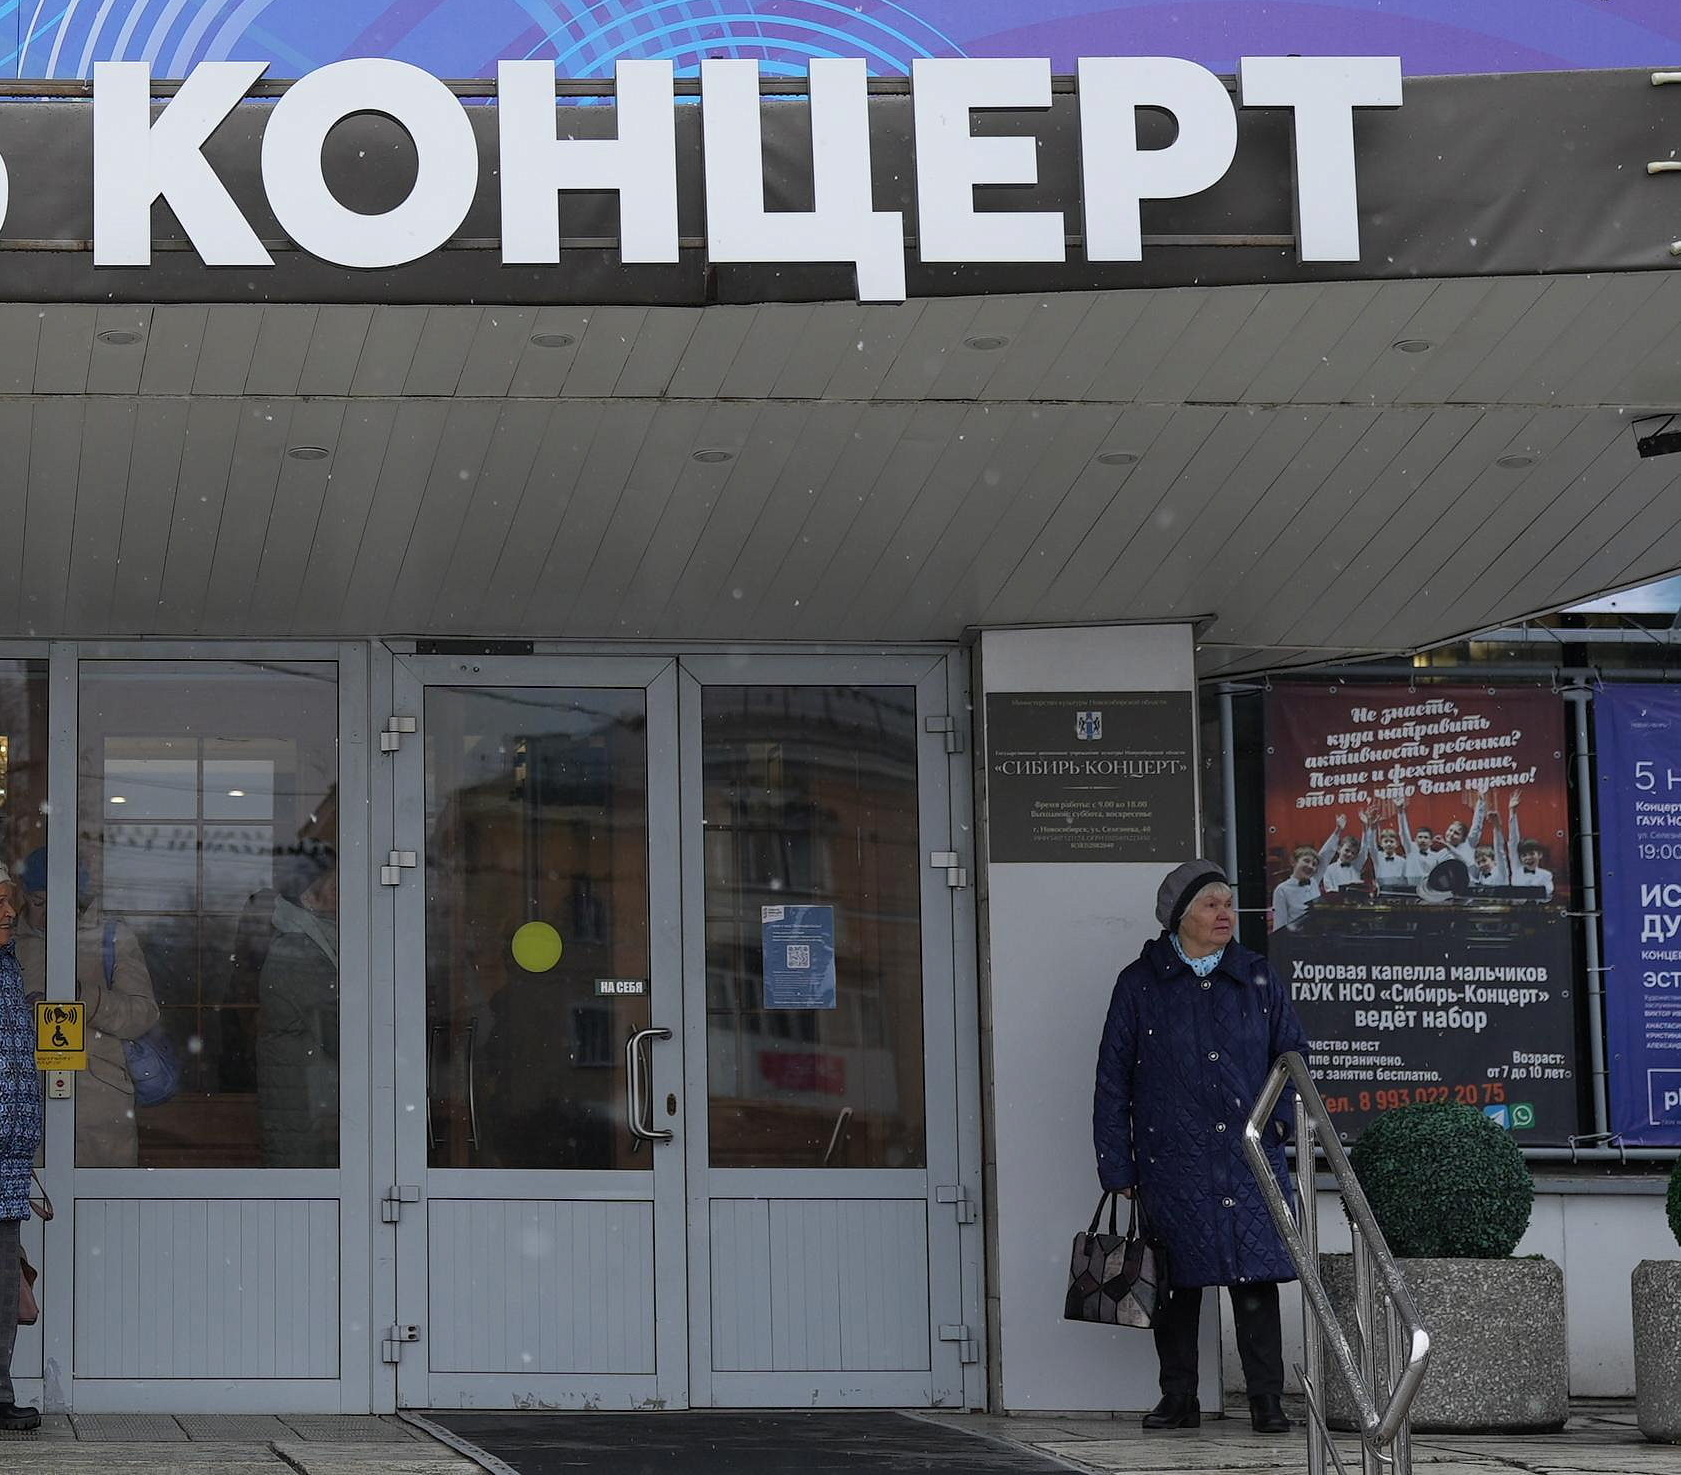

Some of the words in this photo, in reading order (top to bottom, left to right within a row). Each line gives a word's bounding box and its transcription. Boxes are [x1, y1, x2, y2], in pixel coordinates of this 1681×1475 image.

[93, 55, 1402, 302] КОНЦЕРТ
[1351, 707, 1377, 724] Не
[1379, 698, 1459, 725] знаете,
[1326, 728, 1374, 749] куда
[1377, 714, 1491, 741] направить
[1304, 741, 1429, 769] активность
[1432, 730, 1521, 759] ребенка?
[994, 760, 1187, 778] «СИБИРЬ-КОНЦЕРТ»
[1309, 770, 1368, 788] Пение
[1371, 770, 1385, 782] и
[1387, 755, 1518, 785] фехтование,
[1635, 761, 1655, 791] 5
[1295, 791, 1334, 809] это
[1338, 787, 1370, 806] то,
[1374, 781, 1415, 800] что
[1418, 777, 1462, 796] Вам
[1465, 766, 1537, 794] нужно!
[1035, 801, 1060, 810] Время
[1061, 802, 1091, 810] работы:
[1072, 811, 1104, 819] суббота,
[1105, 812, 1152, 820] воскресенье
[1637, 816, 1665, 826] ГАУК
[1639, 844, 1681, 860] 19:00
[1641, 914, 1681, 943] ДУ
[1641, 950, 1681, 962] КОНЦЕ
[1292, 960, 1367, 984] Хоровая
[1371, 964, 1445, 982] капелла
[1451, 966, 1548, 983] мальчиков
[1643, 972, 1681, 988] ЭСТ
[601, 981, 615, 993] НА
[616, 981, 643, 993] СЕБЯ
[1291, 982, 1334, 1002] ГАУК
[1339, 983, 1375, 1002] НСО
[1380, 984, 1550, 1008] «Сибирь-Концерт»
[1355, 1006, 1417, 1031] ведёт
[1422, 1006, 1488, 1033] набор
[1308, 1041, 1349, 1051] чество
[1352, 1042, 1380, 1052] мест
[1332, 1056, 1405, 1069] ограничено.
[1513, 1051, 1566, 1066] Возраст:
[1326, 1070, 1374, 1081] занятие
[1376, 1070, 1442, 1083] бесплатно.
[1487, 1068, 1500, 1079] от
[1502, 1067, 1509, 1078] 7
[1511, 1068, 1526, 1080] до
[1528, 1066, 1541, 1079] 10
[1543, 1068, 1566, 1079] лет
[1359, 1092, 1370, 1111] 8
[1375, 1088, 1410, 1109] 993
[1455, 1086, 1478, 1104] 20
[1482, 1083, 1506, 1103] 75
